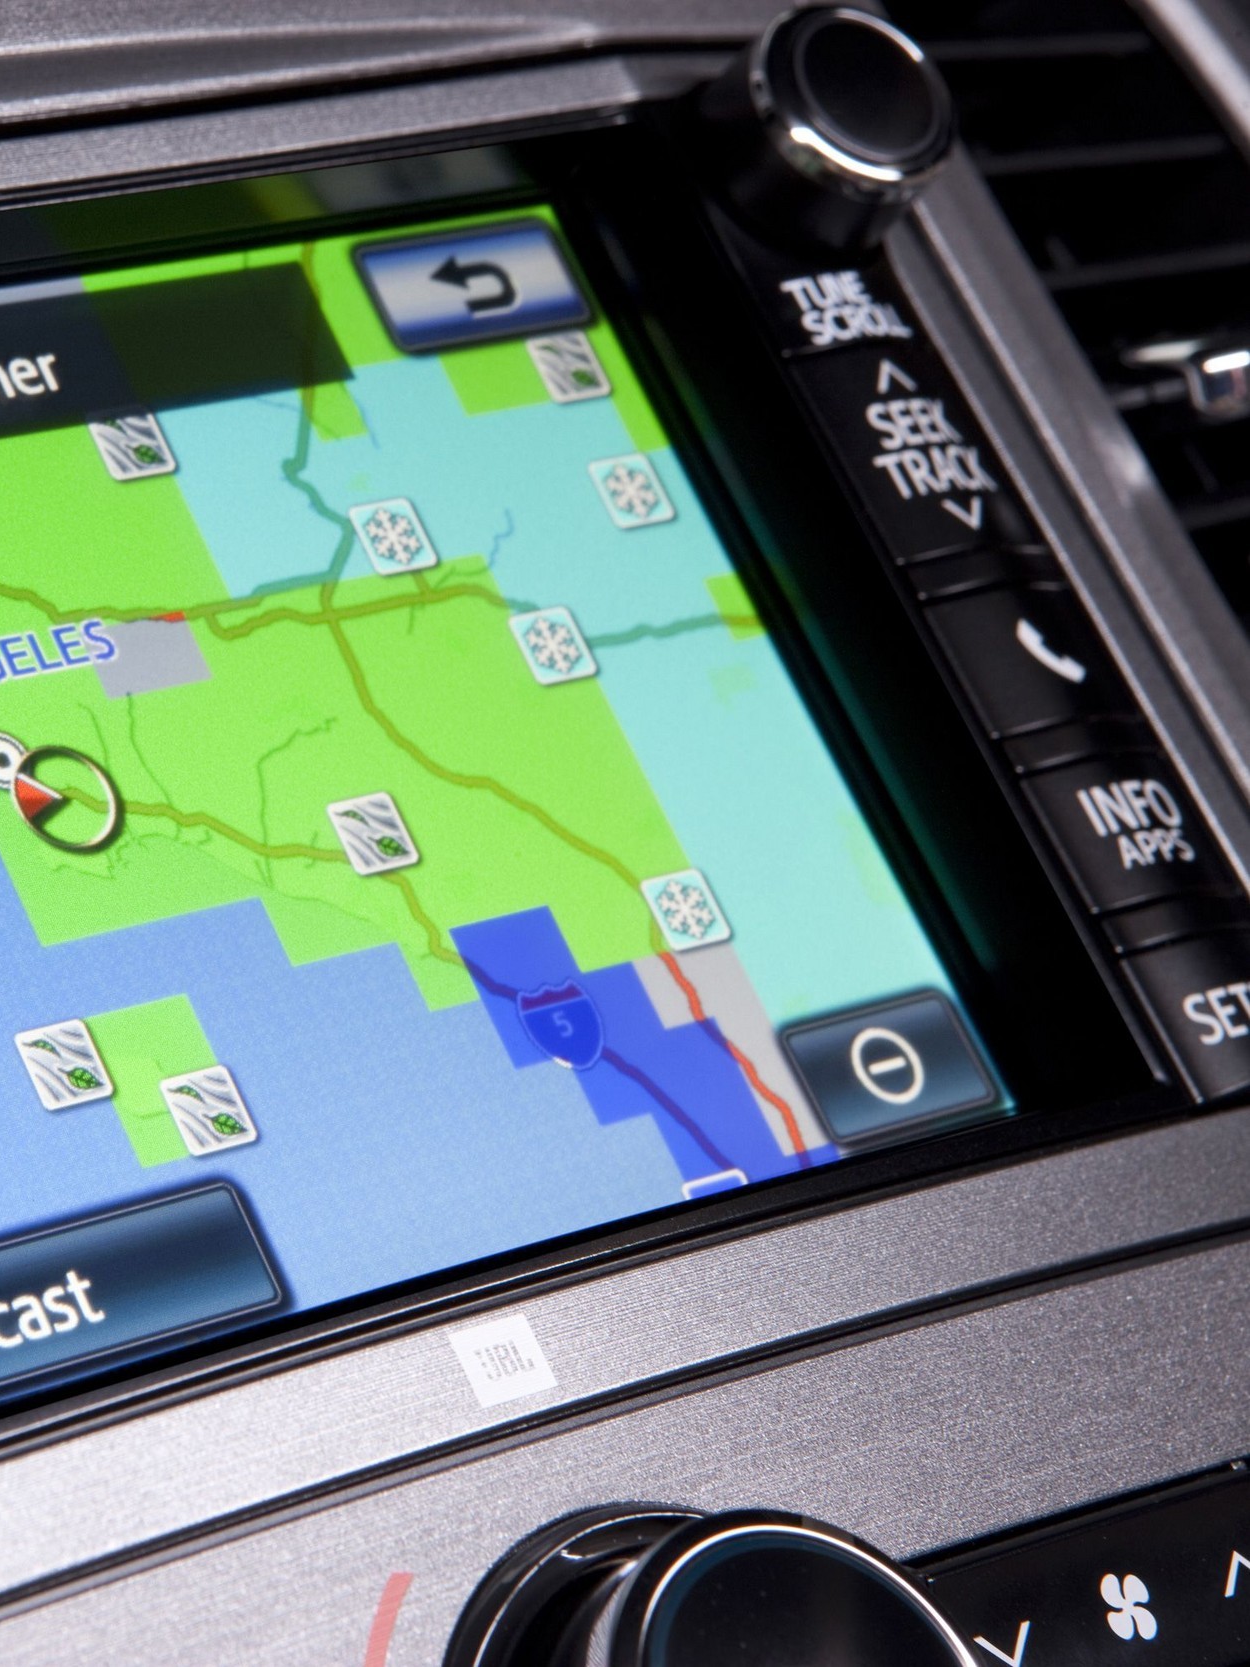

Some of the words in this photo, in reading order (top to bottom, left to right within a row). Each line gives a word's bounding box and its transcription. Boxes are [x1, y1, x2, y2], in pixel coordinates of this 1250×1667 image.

[781, 270, 872, 307] TUNE
[801, 303, 913, 345] SCROLL
[866, 399, 962, 450] SEEK
[873, 446, 997, 500] TRACK
[1076, 779, 1183, 837] INFO
[1116, 828, 1196, 870] APPS
[552, 1010, 574, 1037] 5
[1182, 982, 1250, 1045] SET
[472, 1339, 536, 1382] JBL
